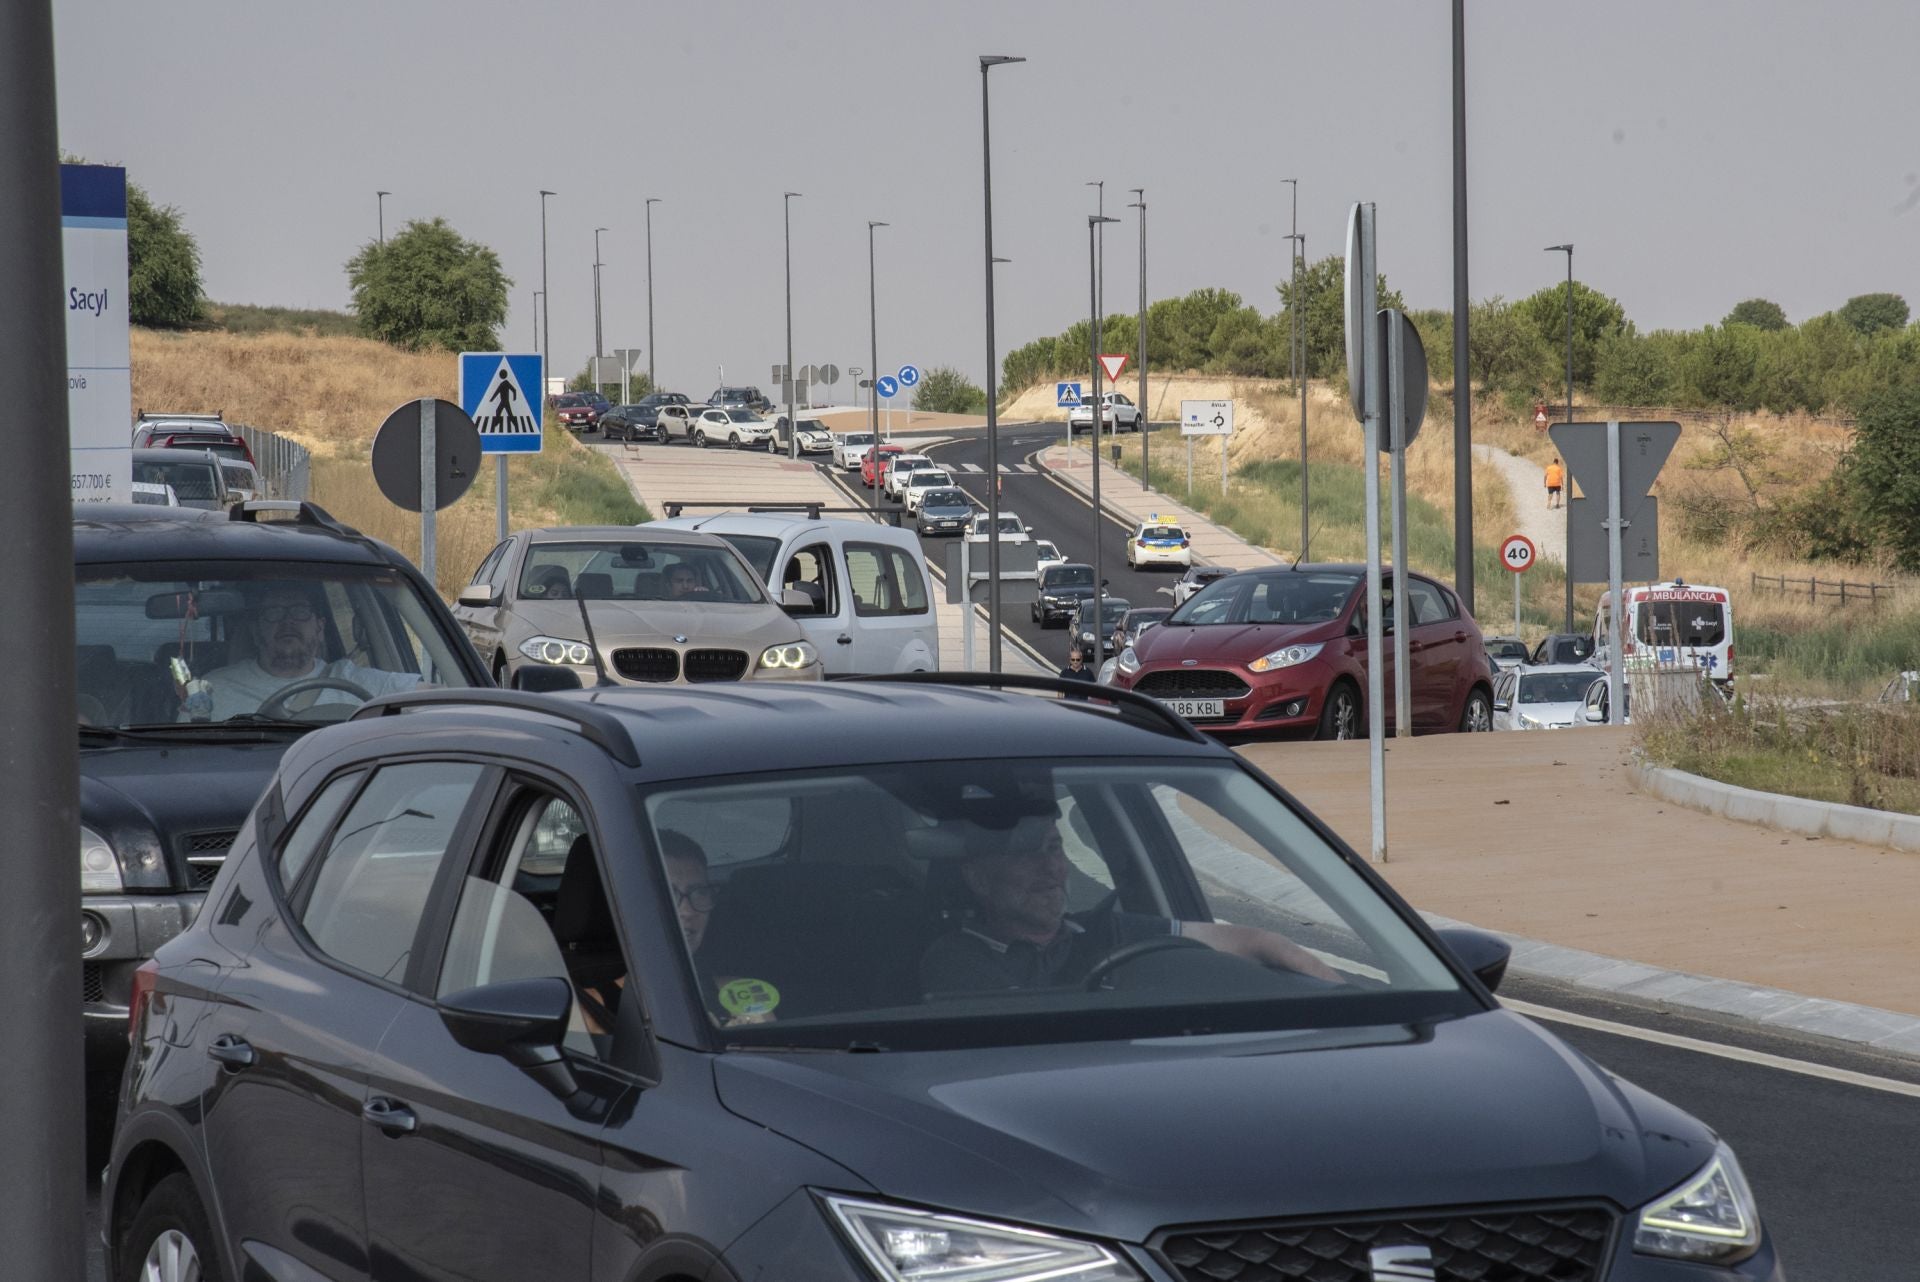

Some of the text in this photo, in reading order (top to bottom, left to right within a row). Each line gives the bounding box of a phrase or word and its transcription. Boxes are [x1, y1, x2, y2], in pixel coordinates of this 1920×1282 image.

[70, 287, 107, 317] Sacyl
[67, 375, 87, 389] ovia
[1507, 547, 1529, 560] 40
[1165, 702, 1220, 714] 186 KBL
